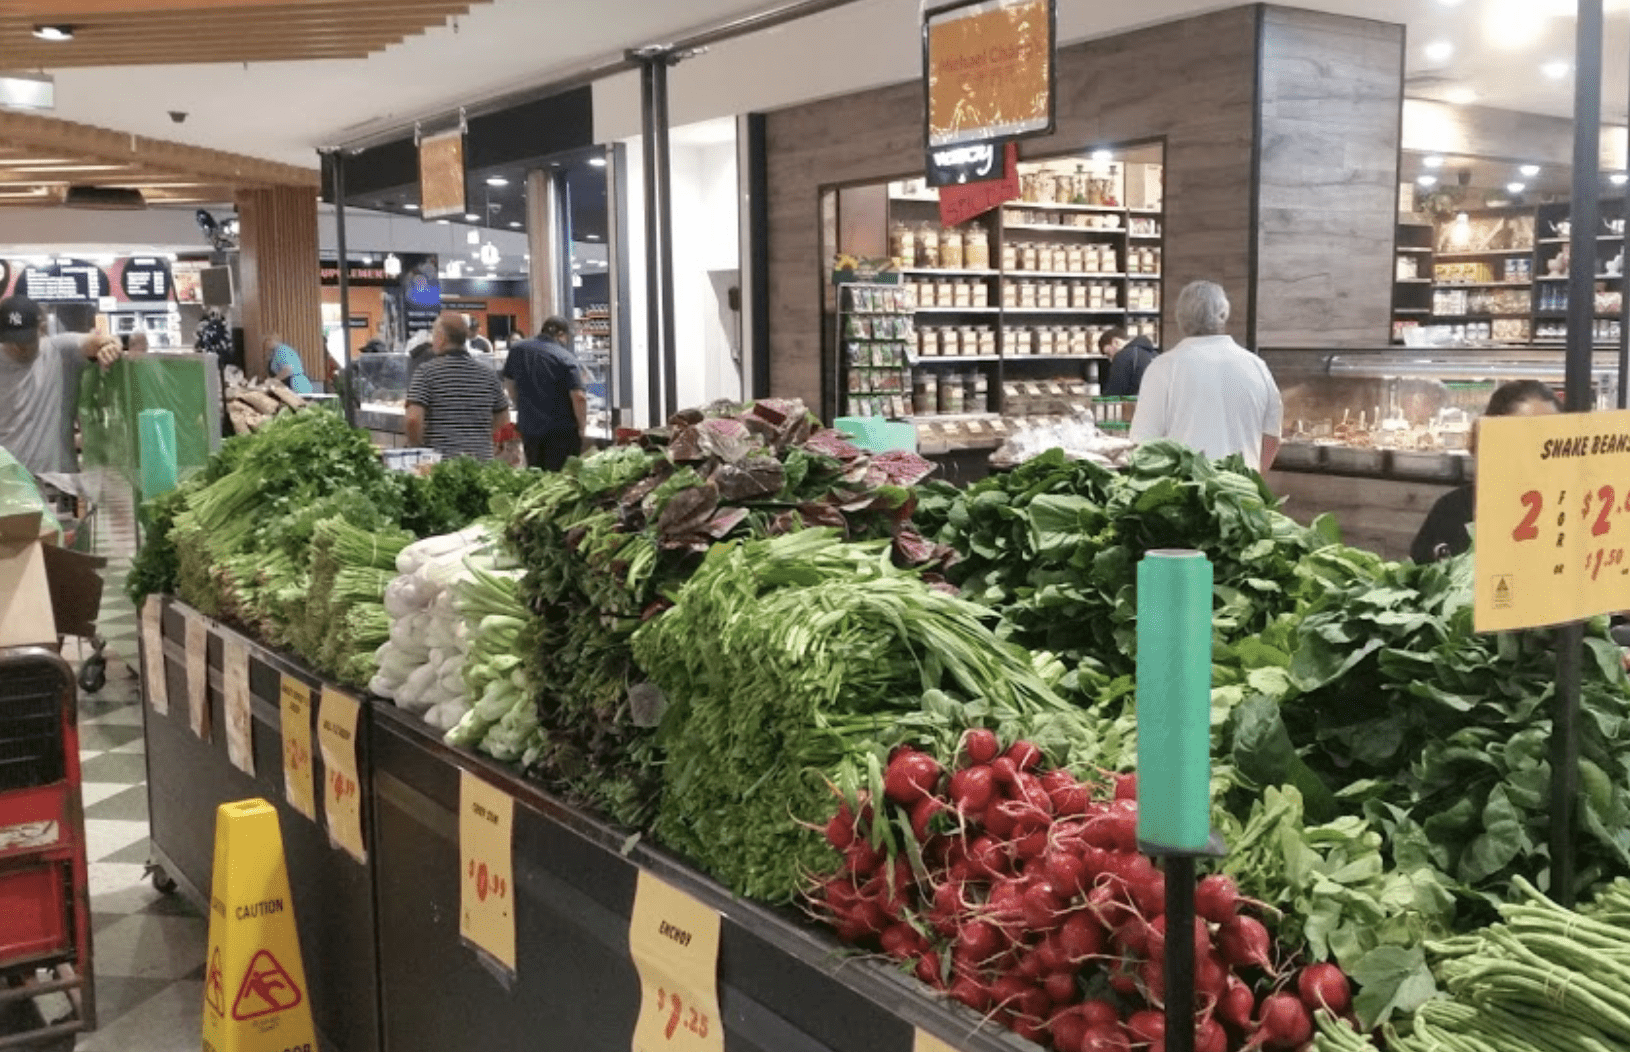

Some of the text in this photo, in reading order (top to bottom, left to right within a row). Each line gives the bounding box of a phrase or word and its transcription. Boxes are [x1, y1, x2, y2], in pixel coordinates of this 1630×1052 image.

[1541, 436, 1589, 460] SNAKE
[1512, 489, 1544, 542] 2
[235, 898, 284, 920] CAUTION
[658, 920, 692, 947] ENCHOY
